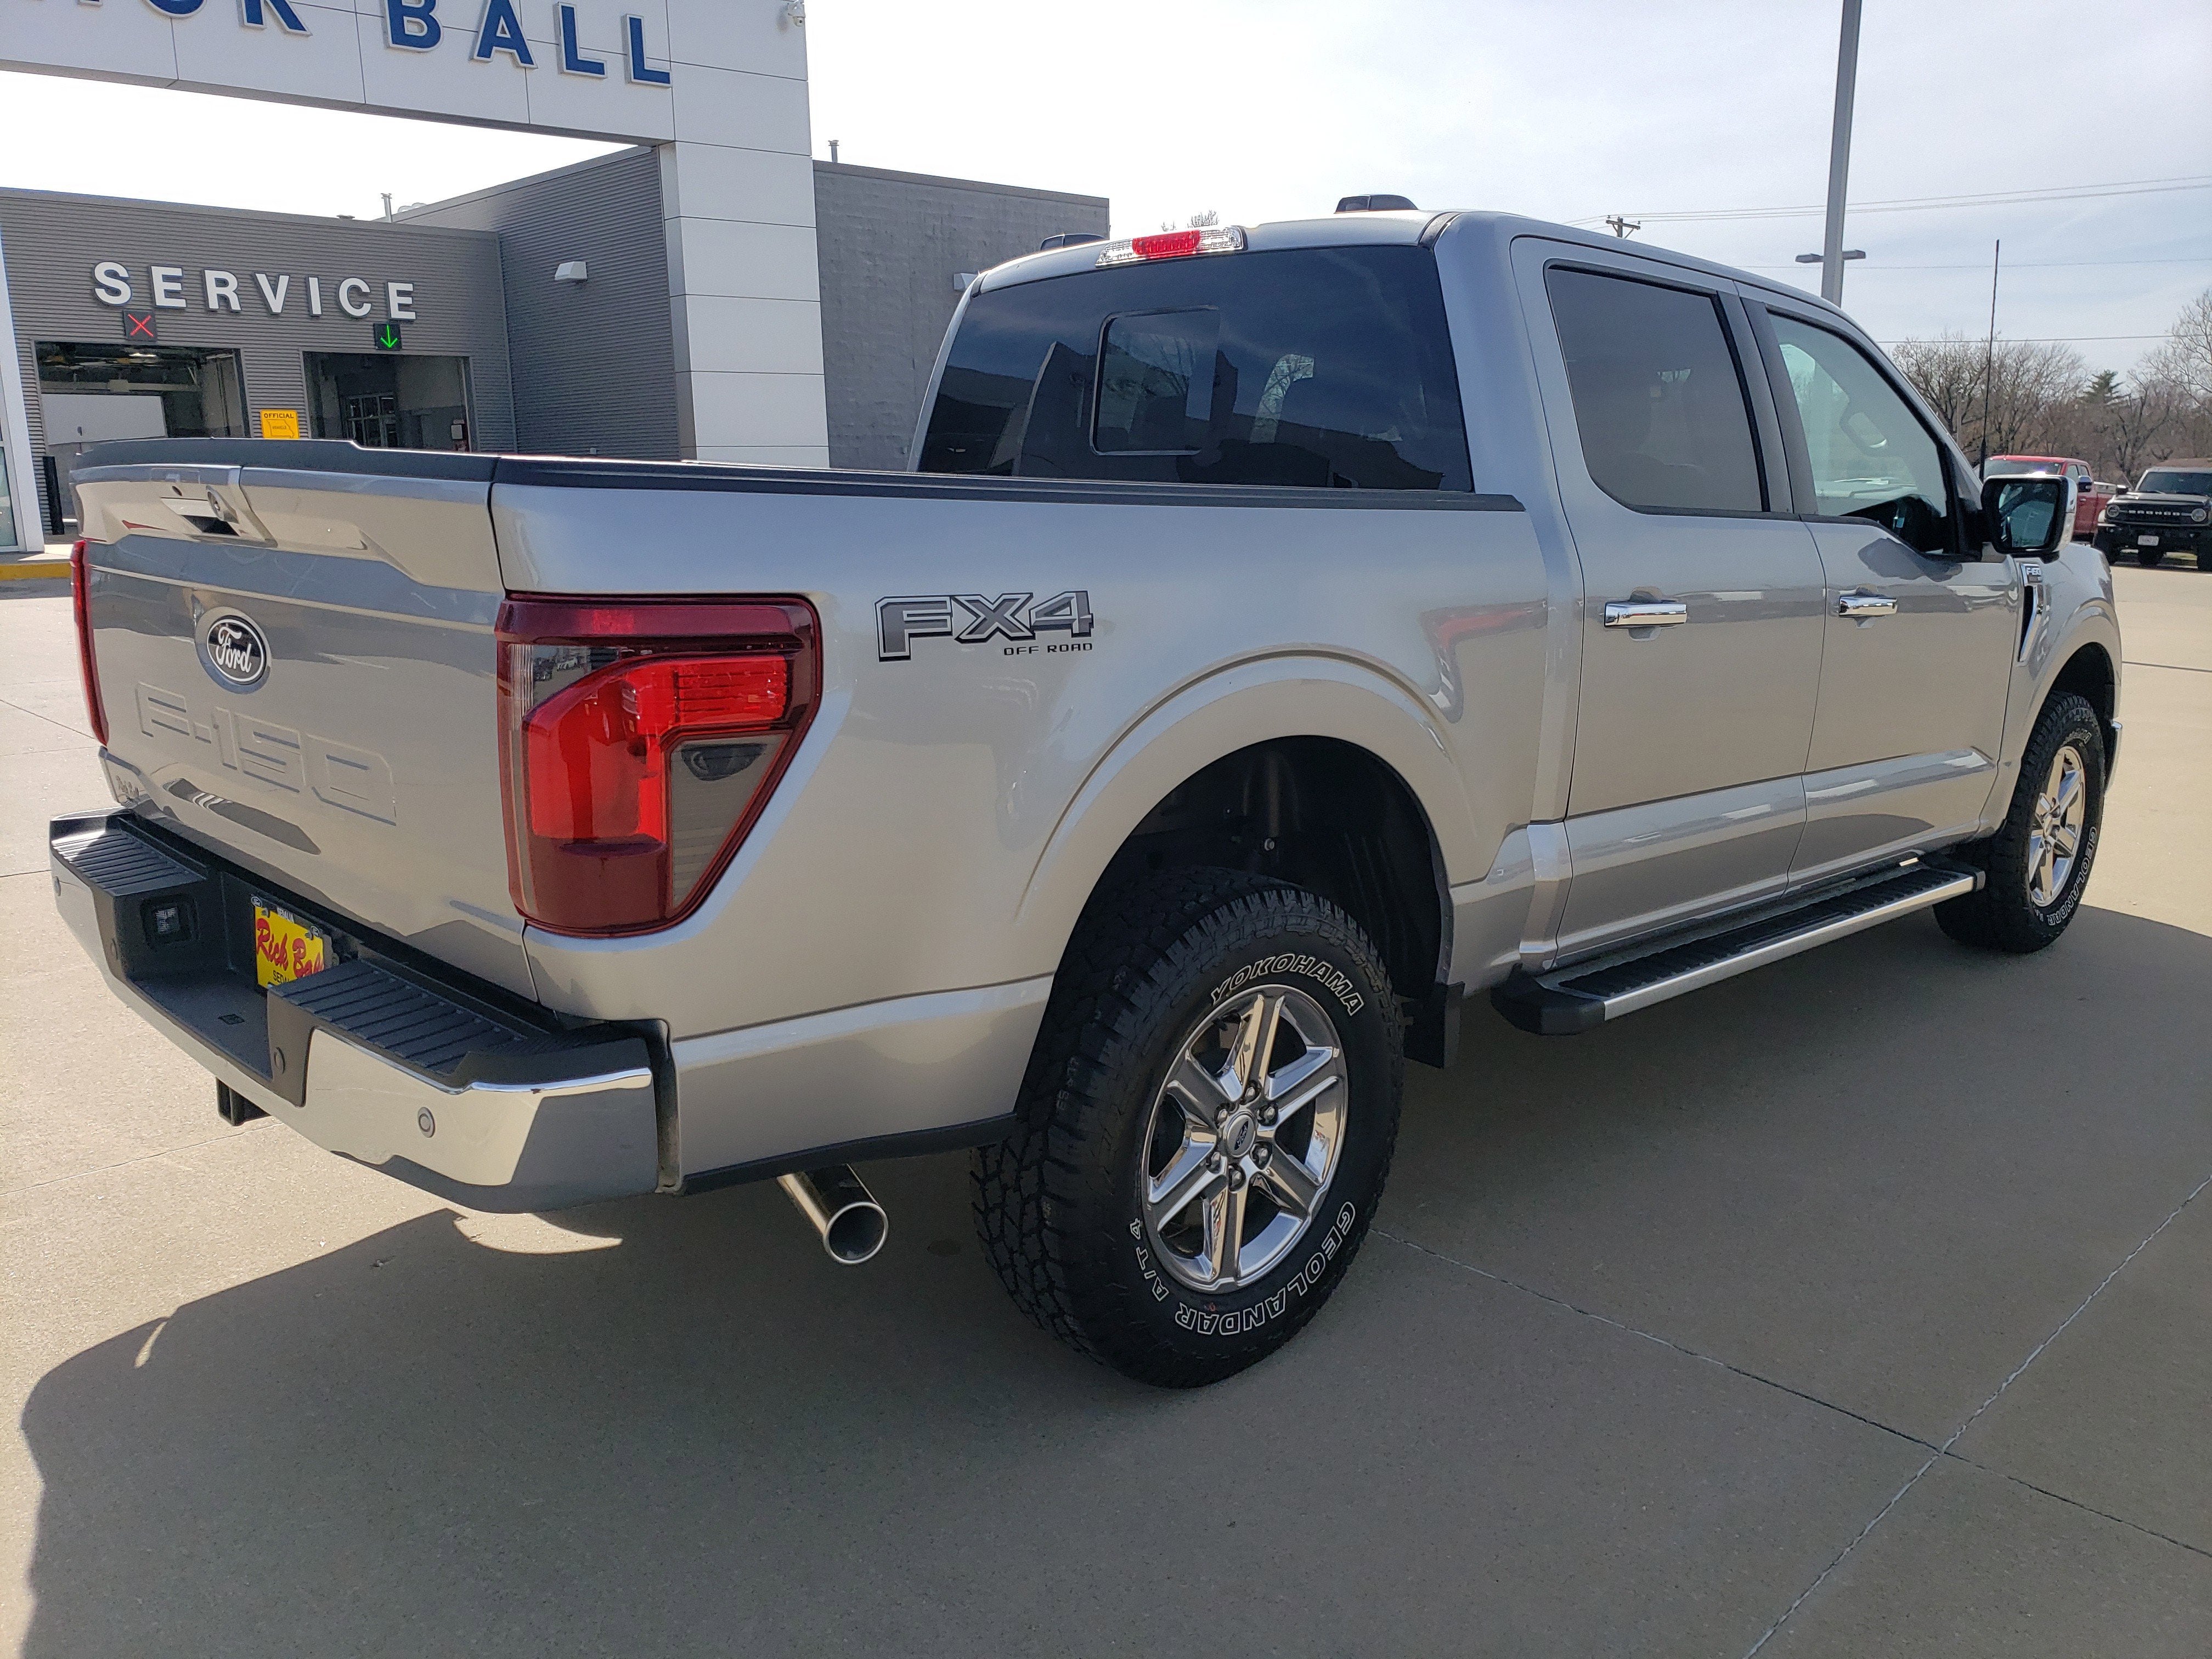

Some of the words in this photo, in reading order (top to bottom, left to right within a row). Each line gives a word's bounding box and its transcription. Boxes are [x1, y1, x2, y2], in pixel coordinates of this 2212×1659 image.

[384, 0, 672, 87] BALL
[93, 261, 417, 320] SERVICE
[216, 626, 252, 673] Ford
[874, 590, 1094, 663] FX4
[1003, 645, 1040, 656] OFF
[1047, 642, 1093, 653] ROAD
[2047, 826, 2097, 926] GEOLANDAR
[256, 918, 289, 971] Rick
[1210, 953, 1364, 1016] YOKOHAMA
[1175, 1201, 1356, 1335] GEOLANDAR
